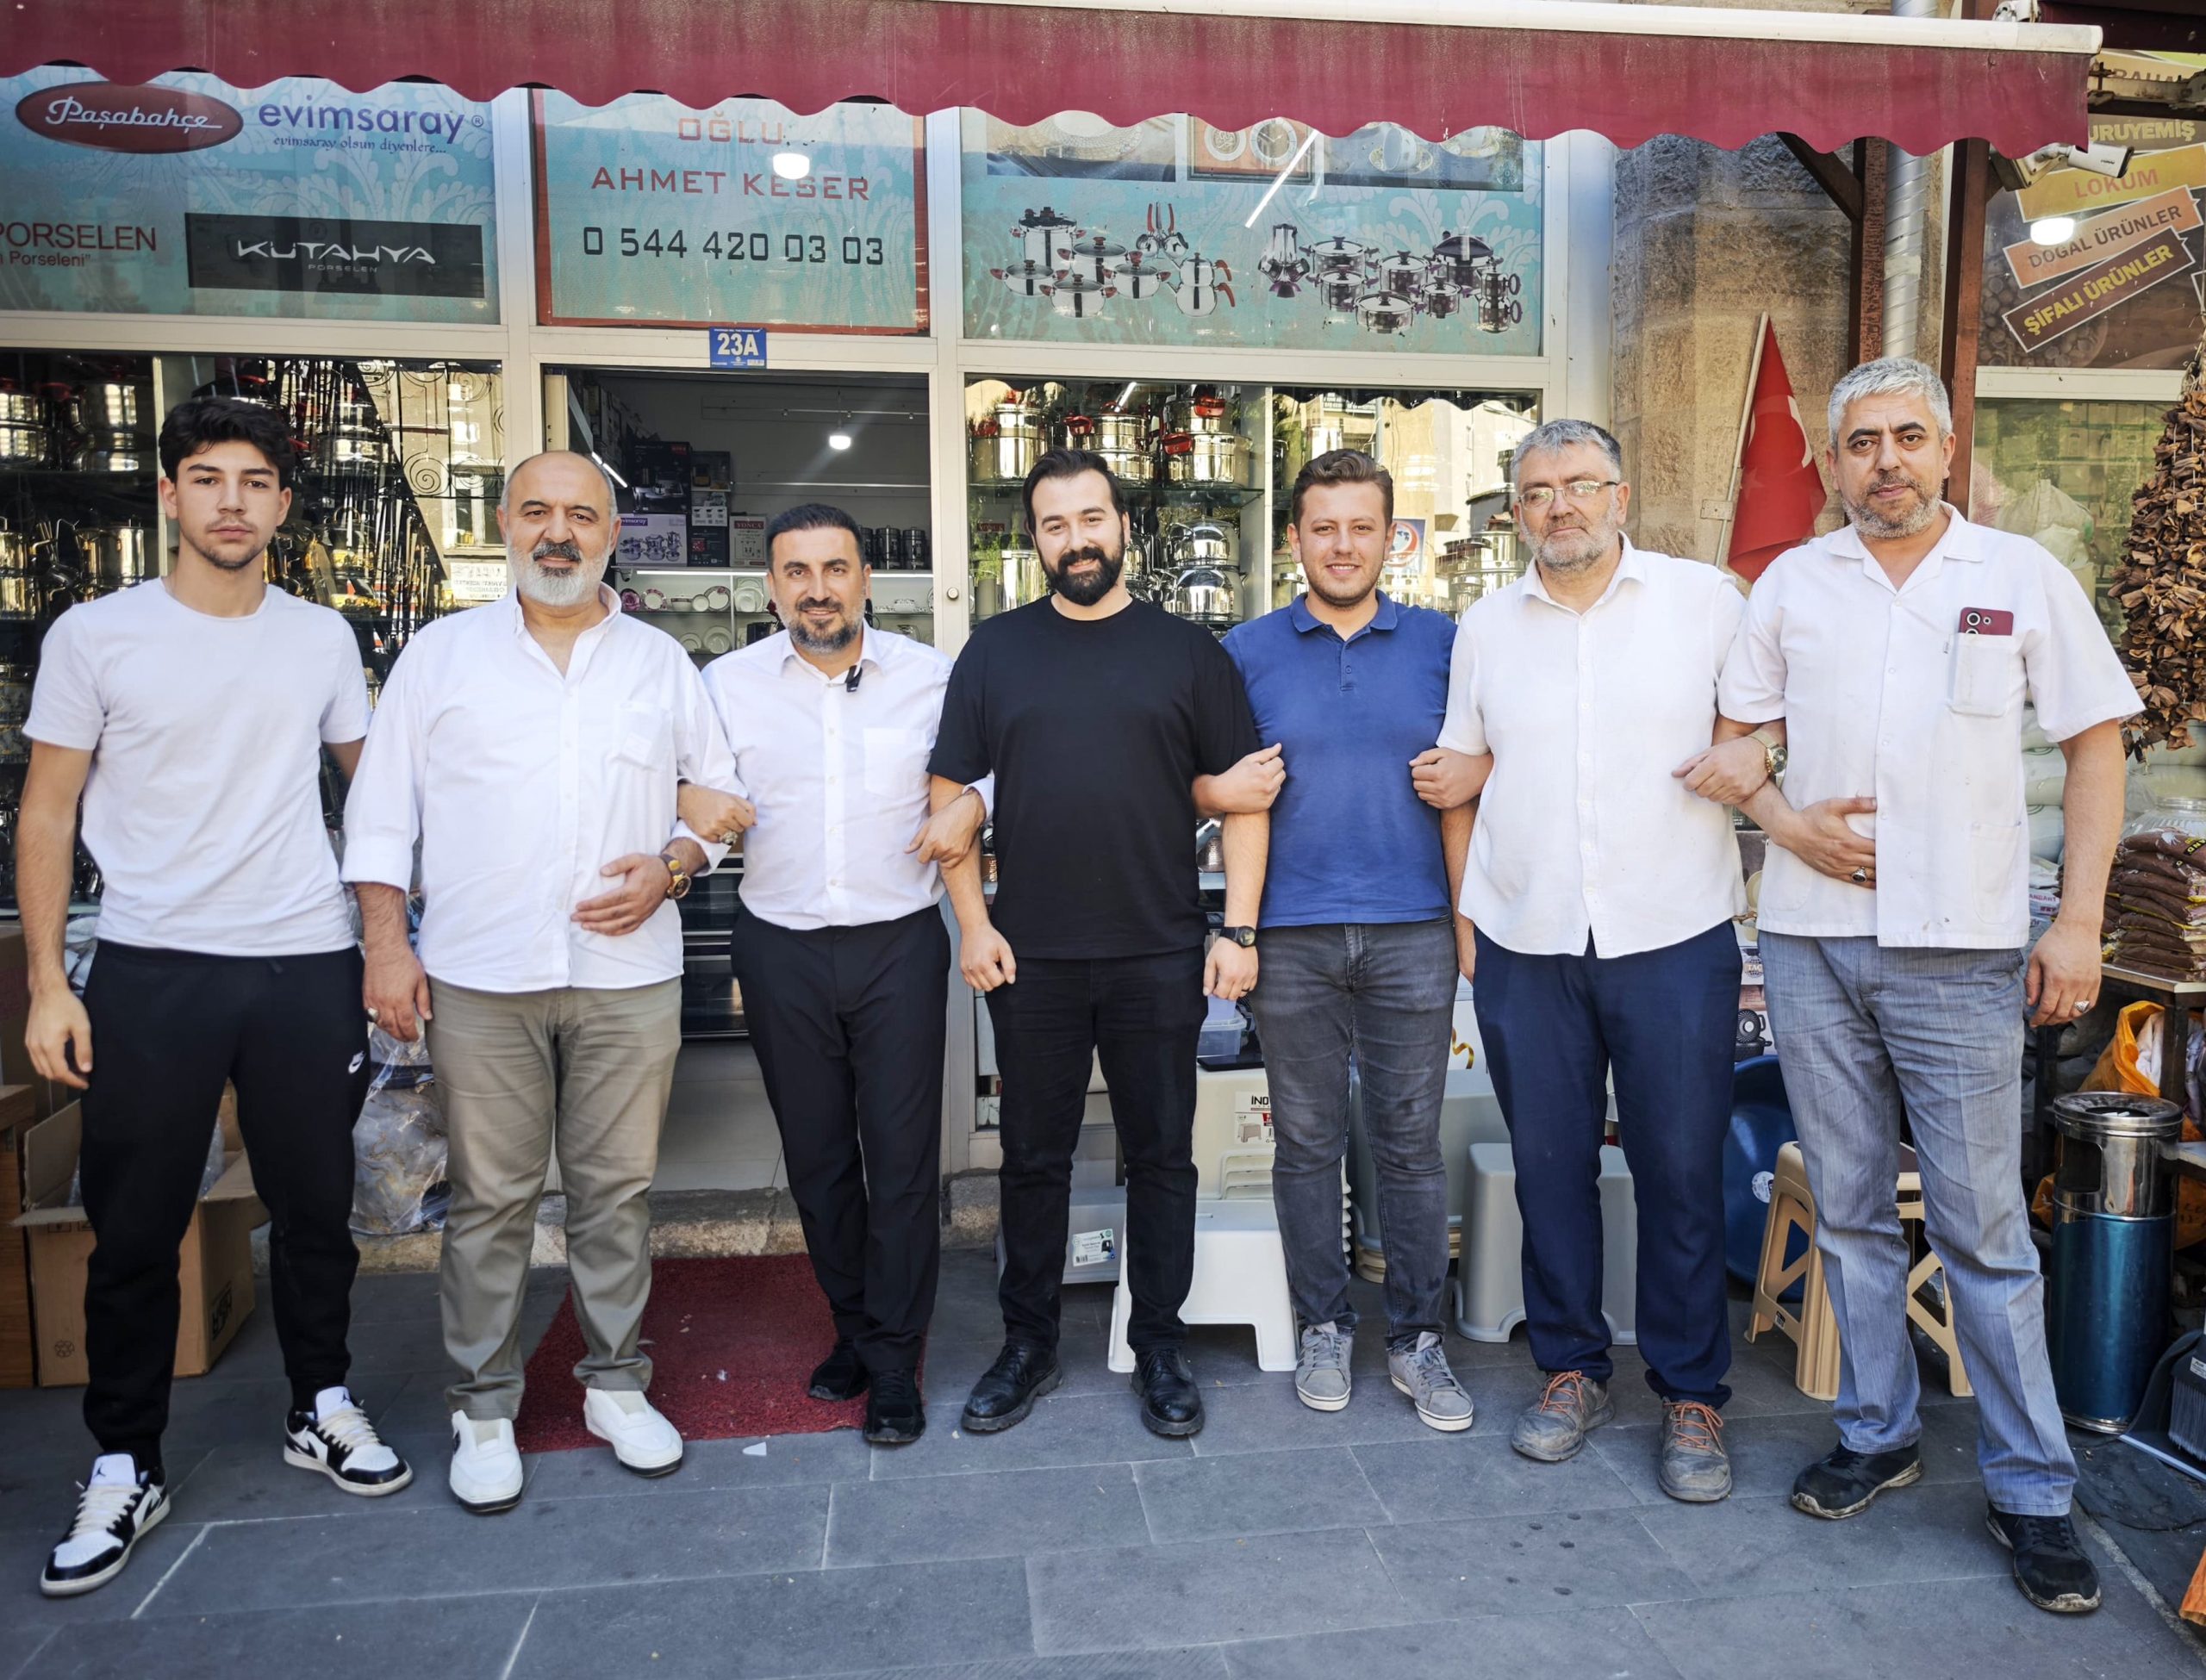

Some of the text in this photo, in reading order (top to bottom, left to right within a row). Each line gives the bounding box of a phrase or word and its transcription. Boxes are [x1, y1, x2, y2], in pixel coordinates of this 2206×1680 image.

[45, 96, 222, 131] Paşabahçe
[259, 95, 464, 144] evimsaray
[677, 112, 782, 145] OĞLU
[273, 135, 337, 151] evimsaray
[340, 136, 375, 150] olsun
[591, 166, 870, 201] AHMET KESER
[2074, 169, 2159, 199] LOKUM
[0, 221, 157, 252] ORSELEN
[2094, 204, 2182, 246] ÜRÜNLER
[583, 227, 884, 265] 0 544 420 03 03
[308, 264, 377, 273] PORSELEN
[2024, 244, 2174, 335] ŞİFALI ÜRÜNLER
[717, 333, 759, 356] 23A
